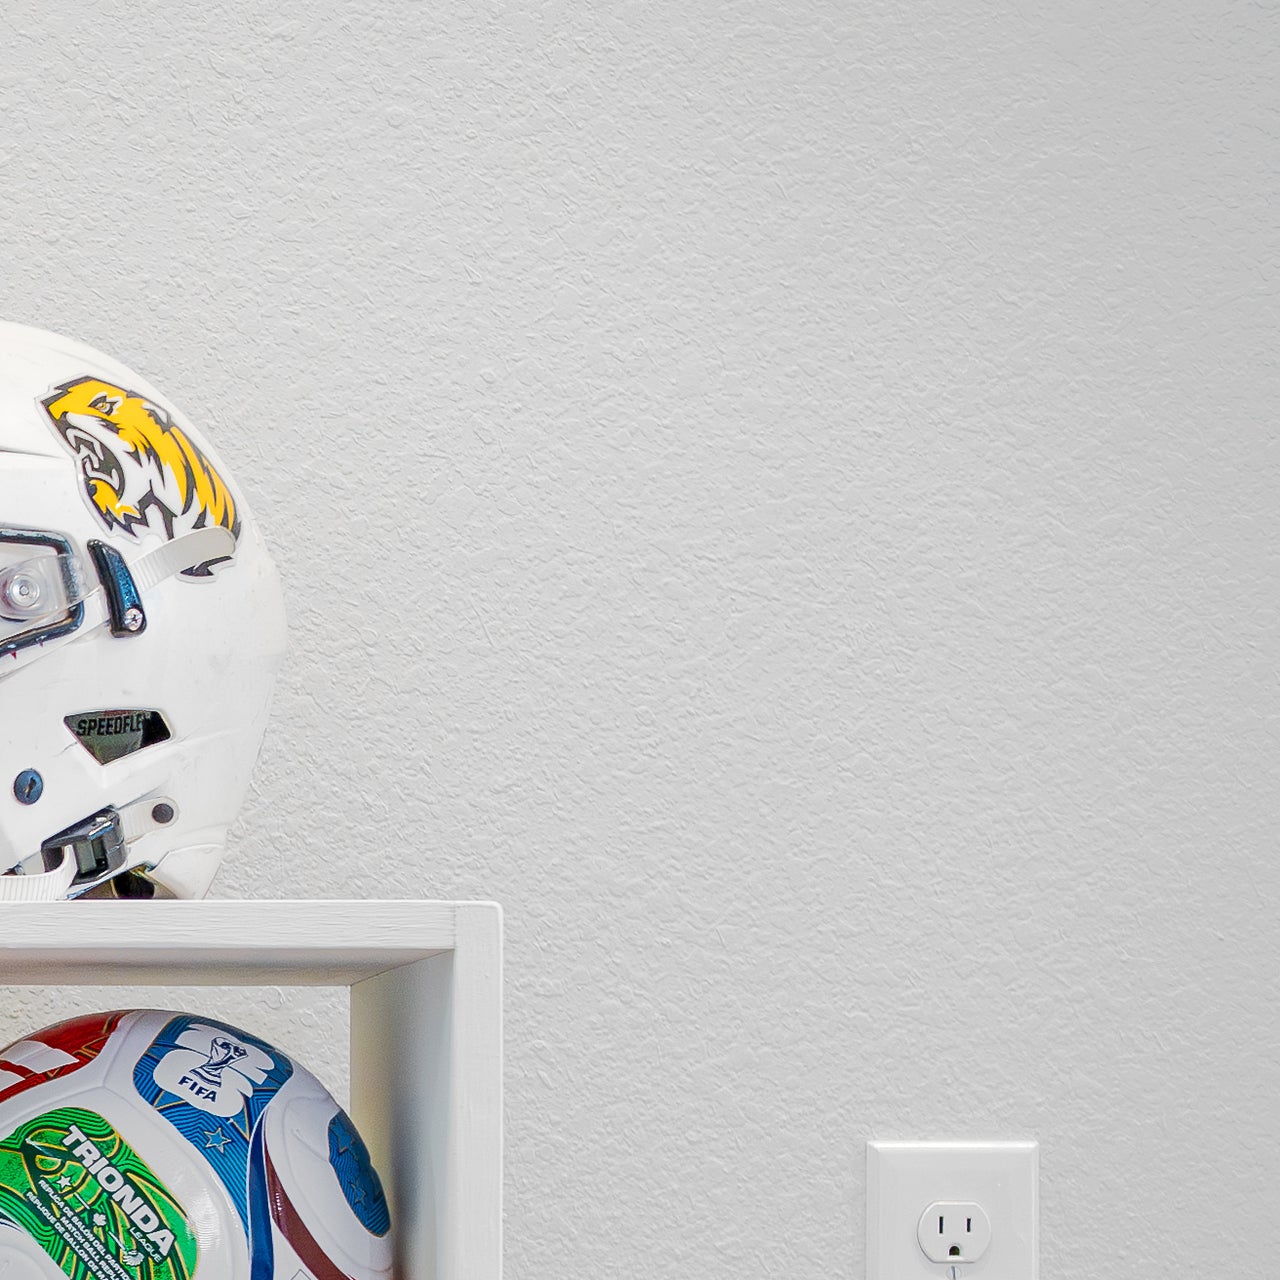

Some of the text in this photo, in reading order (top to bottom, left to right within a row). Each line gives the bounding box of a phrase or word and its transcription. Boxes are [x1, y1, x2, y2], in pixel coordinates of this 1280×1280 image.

[178, 1075, 218, 1103] FIFA
[62, 1124, 176, 1256] TRIONDA
[54, 1222, 65, 1234] DE
[62, 1232, 90, 1262] BALLON
[87, 1260, 98, 1272] DE
[60, 1216, 85, 1243] MATCH
[83, 1242, 101, 1262] BALL
[62, 1207, 74, 1219] DE
[92, 1240, 106, 1255] DEL
[129, 1226, 162, 1263] LEAGUE
